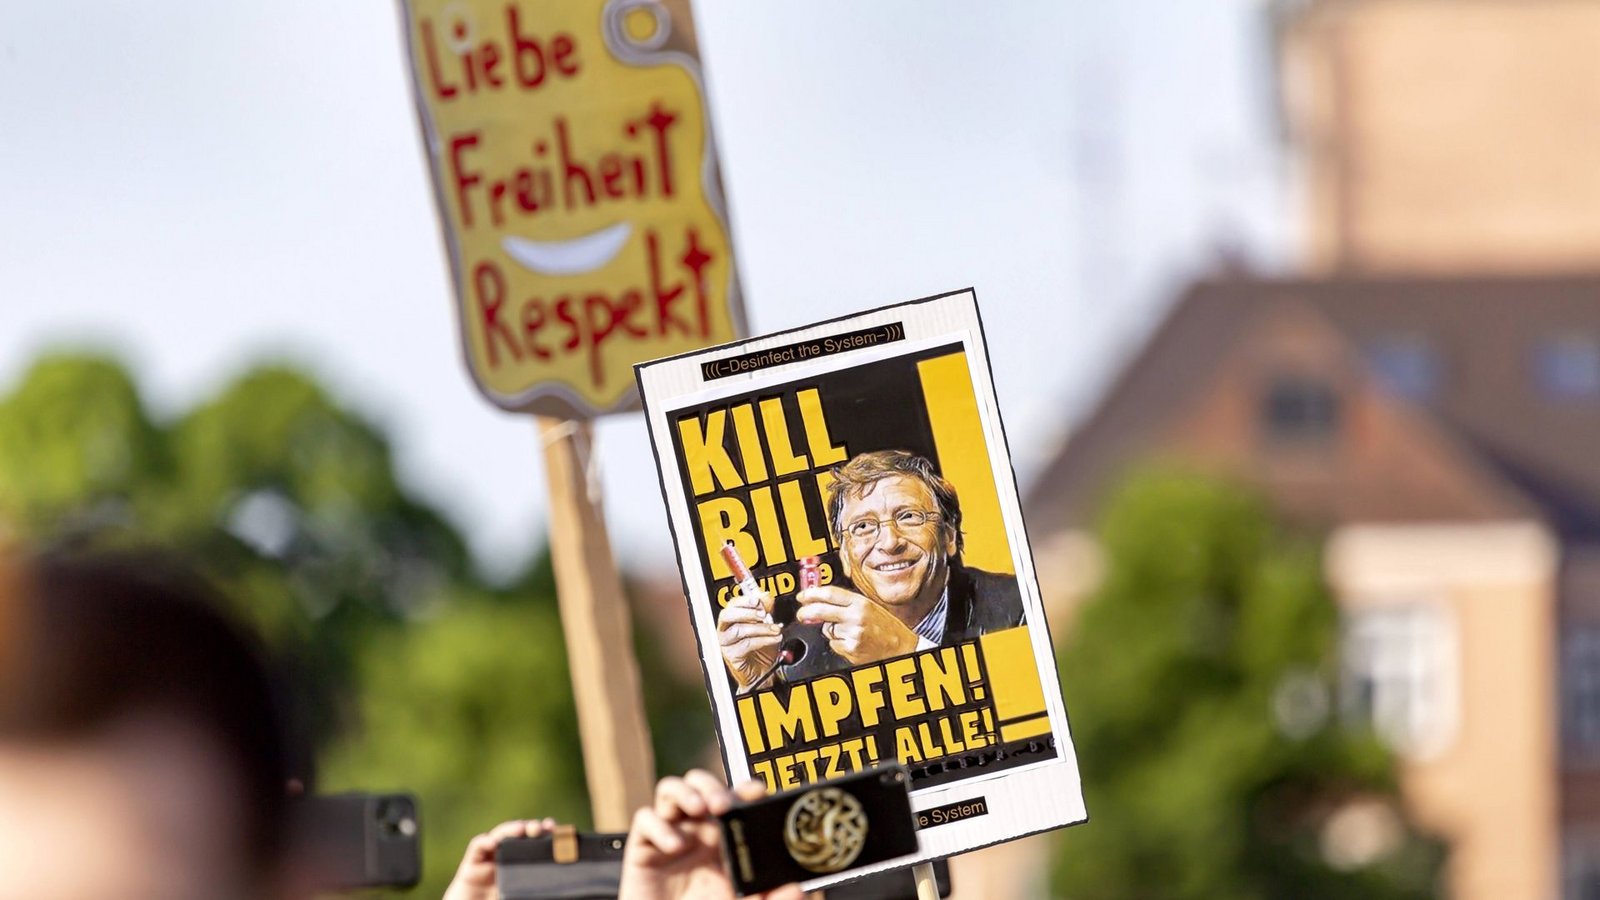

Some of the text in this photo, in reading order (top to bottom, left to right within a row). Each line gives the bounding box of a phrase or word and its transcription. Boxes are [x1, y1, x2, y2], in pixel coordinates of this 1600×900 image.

[419, 4, 580, 99] Liebe
[449, 100, 680, 229] Freiheit
[473, 227, 716, 390] Respekt
[797, 344, 821, 358] the
[678, 388, 848, 497] KILL
[736, 643, 987, 755] IMPFEN!
[753, 707, 997, 796] JETZT! ALLE!
[931, 801, 985, 823] System
